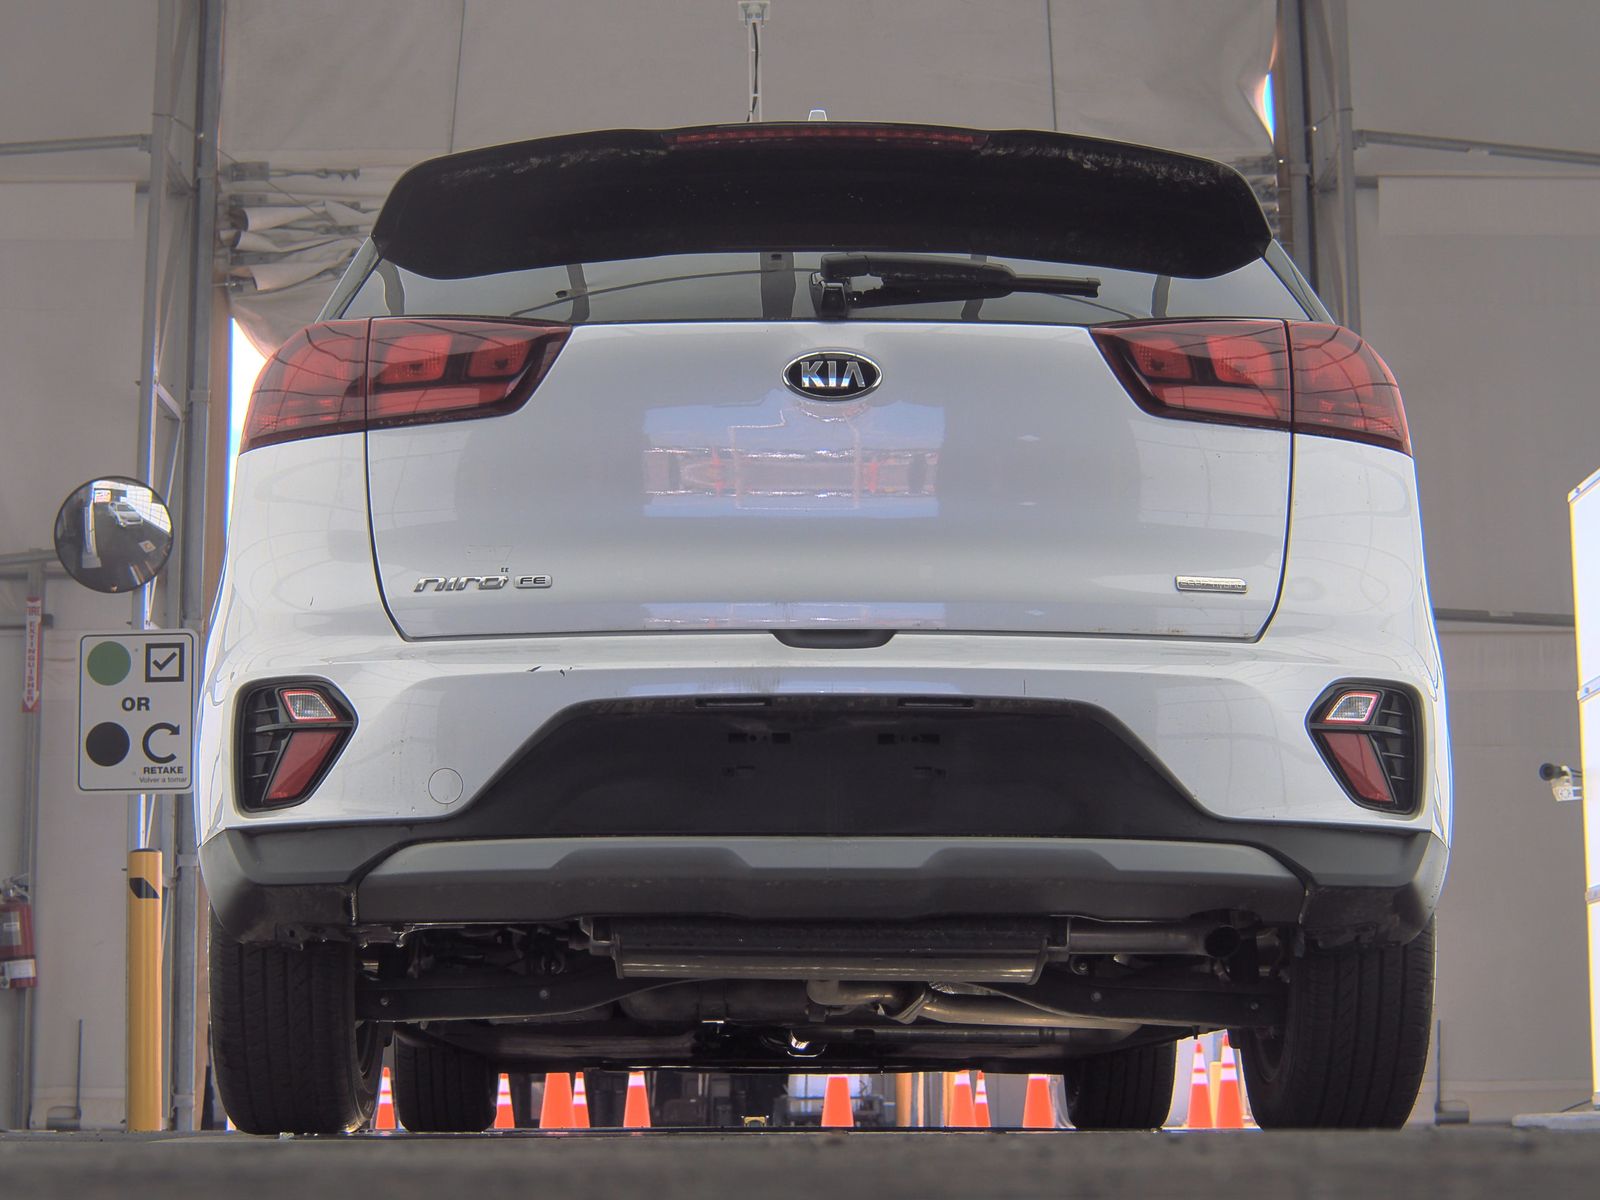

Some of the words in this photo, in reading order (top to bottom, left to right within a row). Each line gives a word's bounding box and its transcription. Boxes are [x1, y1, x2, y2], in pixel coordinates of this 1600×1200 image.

[800, 360, 866, 388] KIA
[518, 575, 548, 586] FE
[121, 696, 151, 712] OR
[143, 766, 184, 775] RETAKE
[139, 776, 160, 784] Volver
[167, 776, 188, 784] tomar
